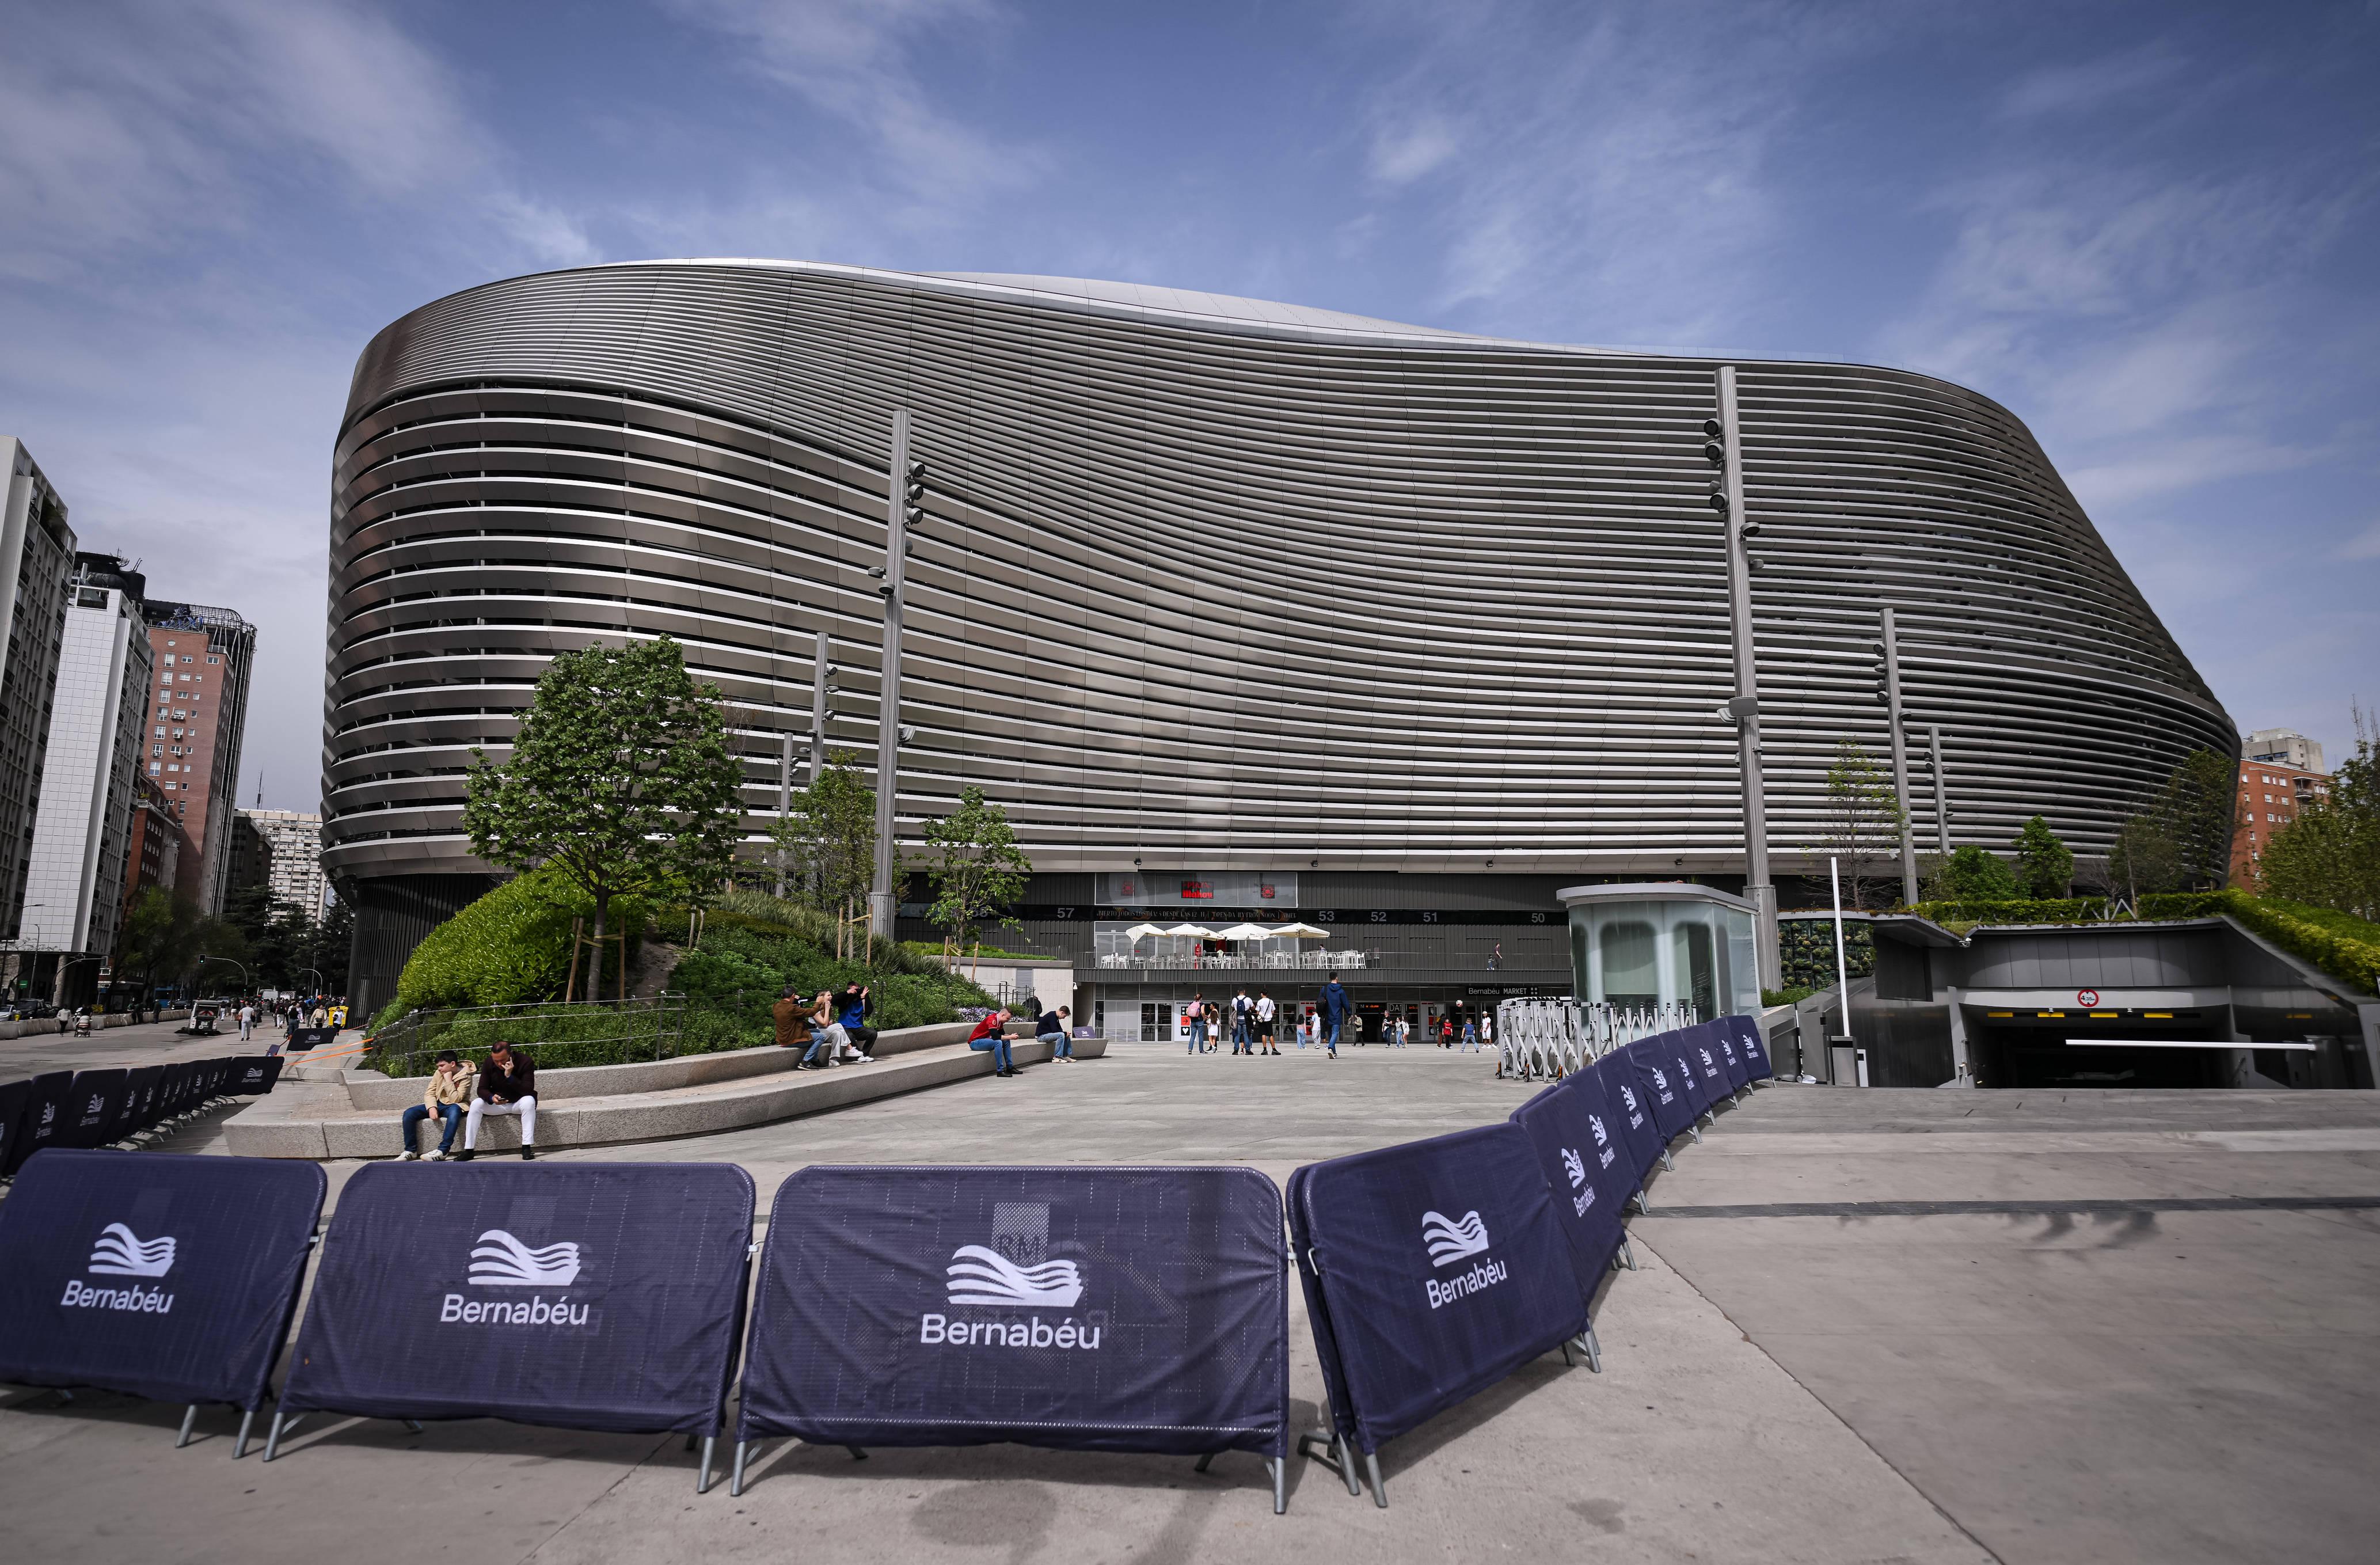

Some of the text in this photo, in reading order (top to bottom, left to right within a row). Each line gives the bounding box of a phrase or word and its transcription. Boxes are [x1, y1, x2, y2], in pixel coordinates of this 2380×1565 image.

[1057, 907, 1074, 918] 57
[1318, 911, 1335, 921] 53
[1371, 911, 1387, 922] 52
[1423, 912, 1437, 922] 51
[1531, 913, 1545, 923] 50
[1599, 1144, 1615, 1169] Bernabéu
[1573, 1183, 1595, 1218] Bernabéu
[1426, 1258, 1507, 1309] Bernabéu
[60, 1280, 174, 1313] Bernabéu
[440, 1294, 589, 1325] Bernabéu
[921, 1313, 1100, 1350] Bernabéu
